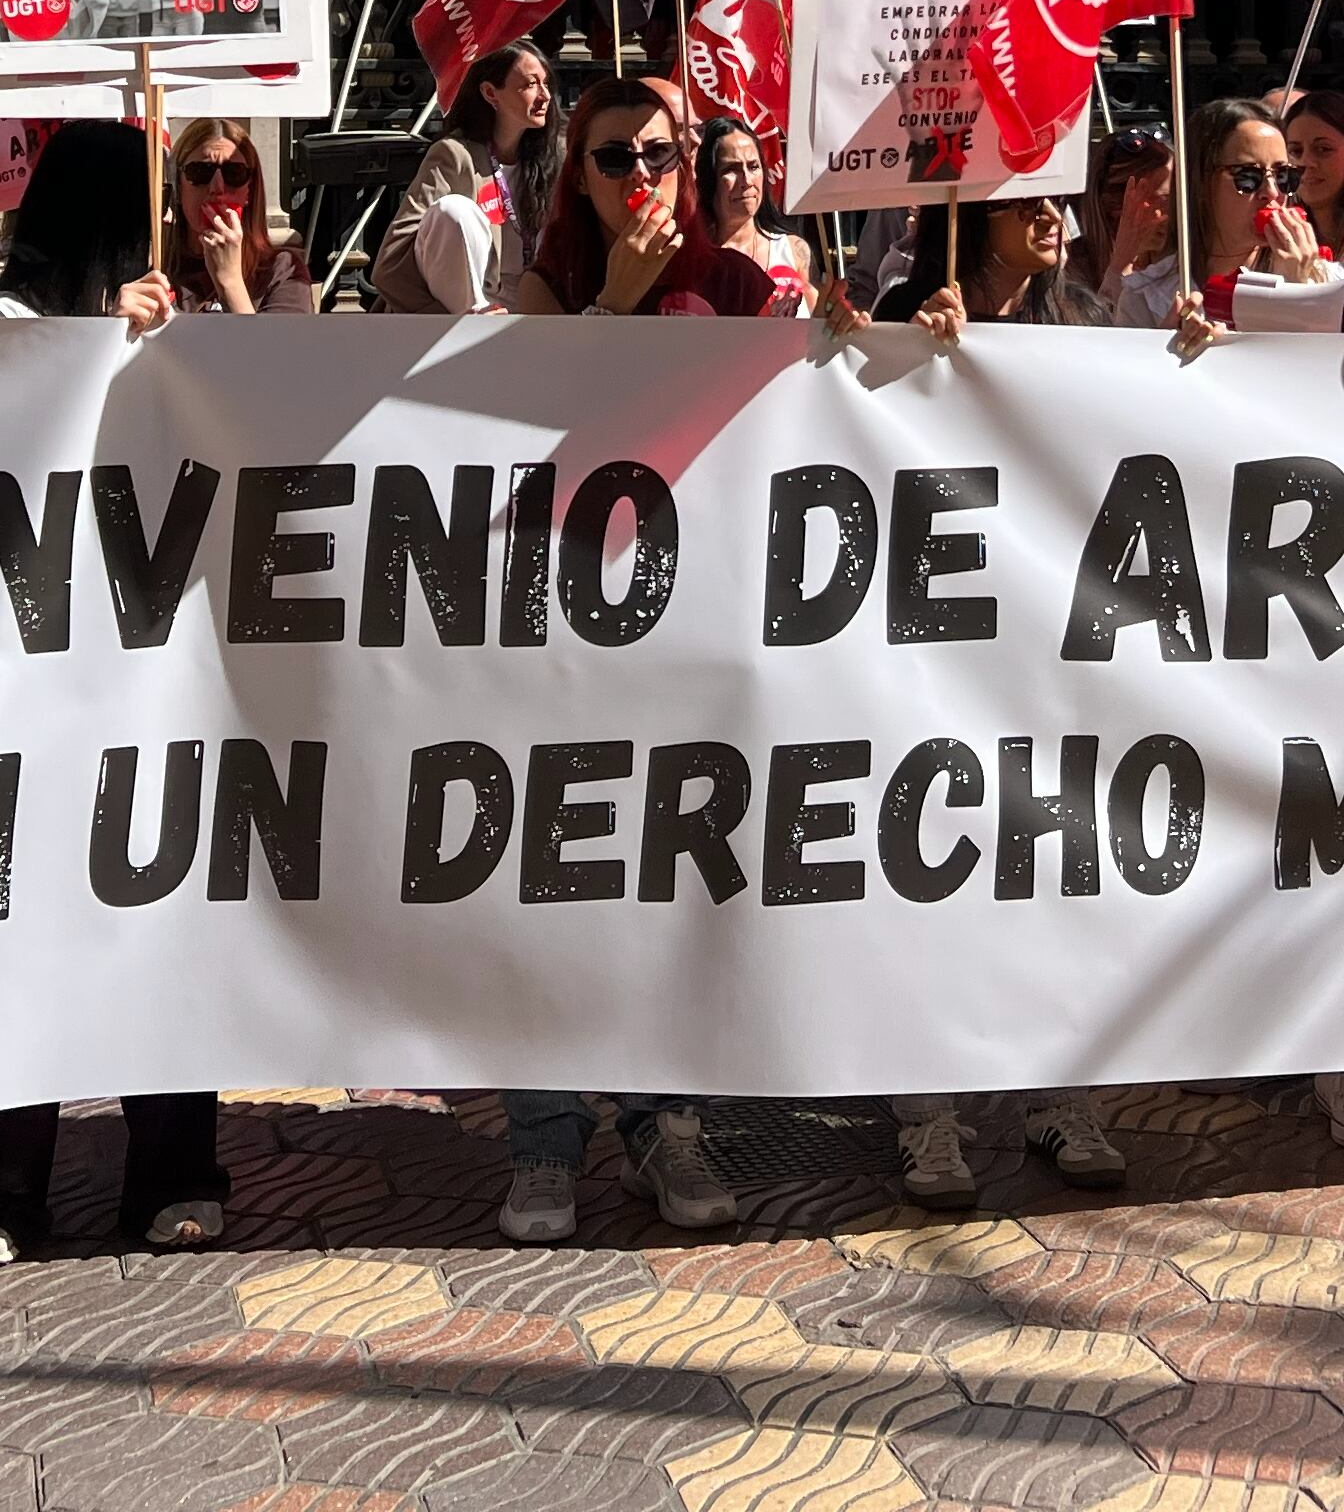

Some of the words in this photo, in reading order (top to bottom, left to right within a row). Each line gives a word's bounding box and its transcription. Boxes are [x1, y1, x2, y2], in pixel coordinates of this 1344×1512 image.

[881, 4, 971, 19] EMPEORAR
[890, 23, 984, 41] CONDICION
[888, 46, 972, 63] LABORAL
[861, 72, 892, 86] ESE
[901, 70, 921, 83] ES
[931, 68, 949, 83] EL
[912, 87, 960, 111] STOP
[898, 110, 978, 128] CONVENIO
[828, 148, 876, 172] UGT
[762, 462, 1000, 649] DE
[88, 738, 329, 908] UN
[400, 734, 1206, 906] DERECHO
